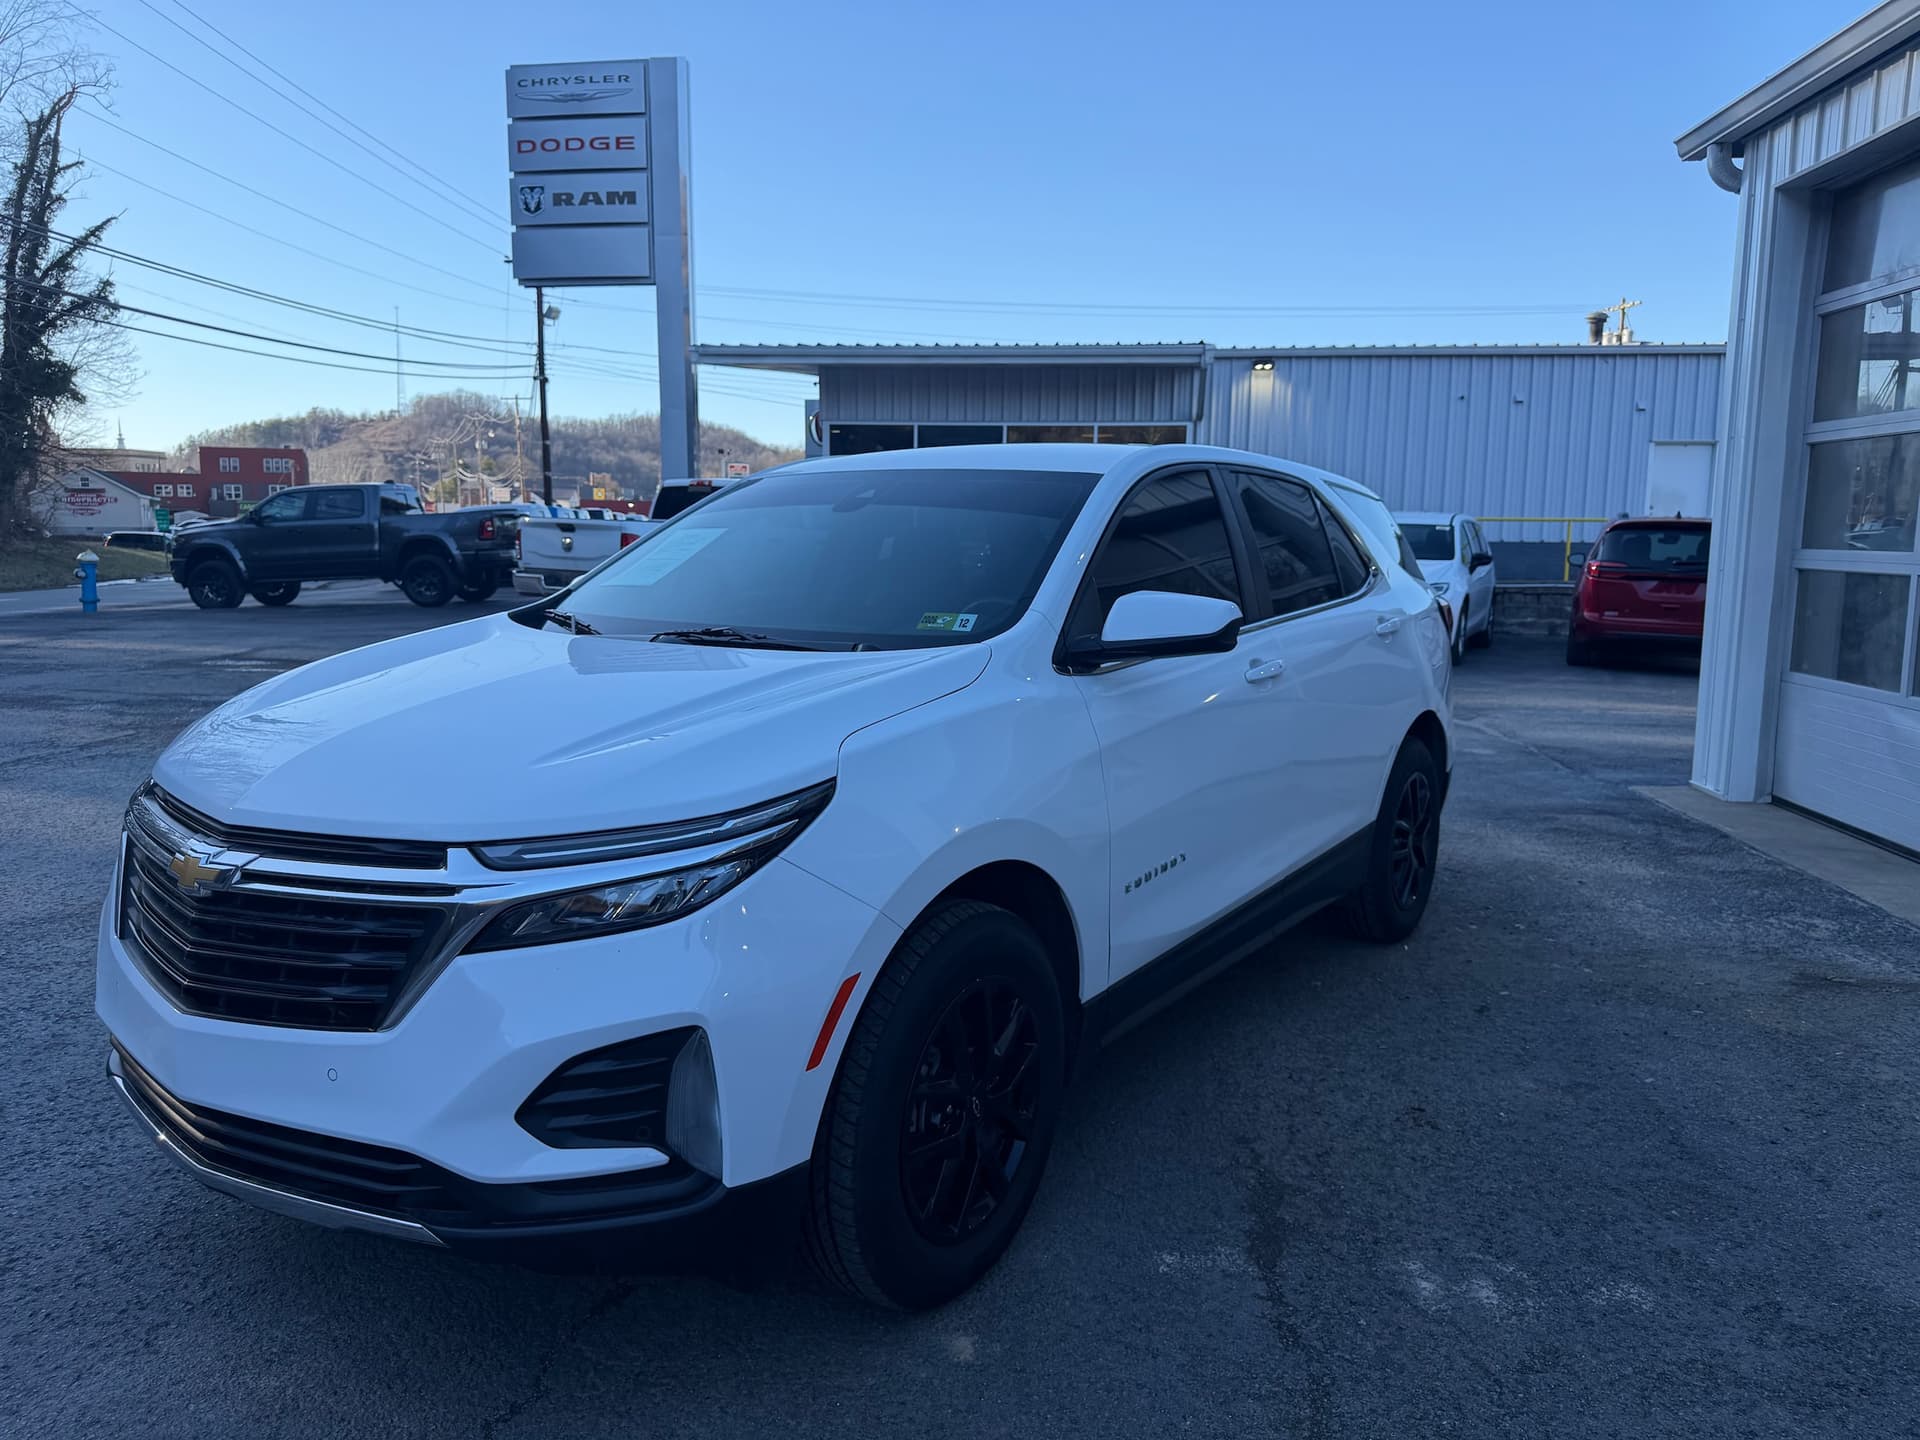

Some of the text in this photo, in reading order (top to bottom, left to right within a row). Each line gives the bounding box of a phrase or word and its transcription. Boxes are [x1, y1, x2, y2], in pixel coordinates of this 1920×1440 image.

[517, 74, 631, 88] CHRYSLER
[516, 136, 636, 154] DODGE
[552, 191, 637, 207] RAM
[958, 618, 970, 628] 12
